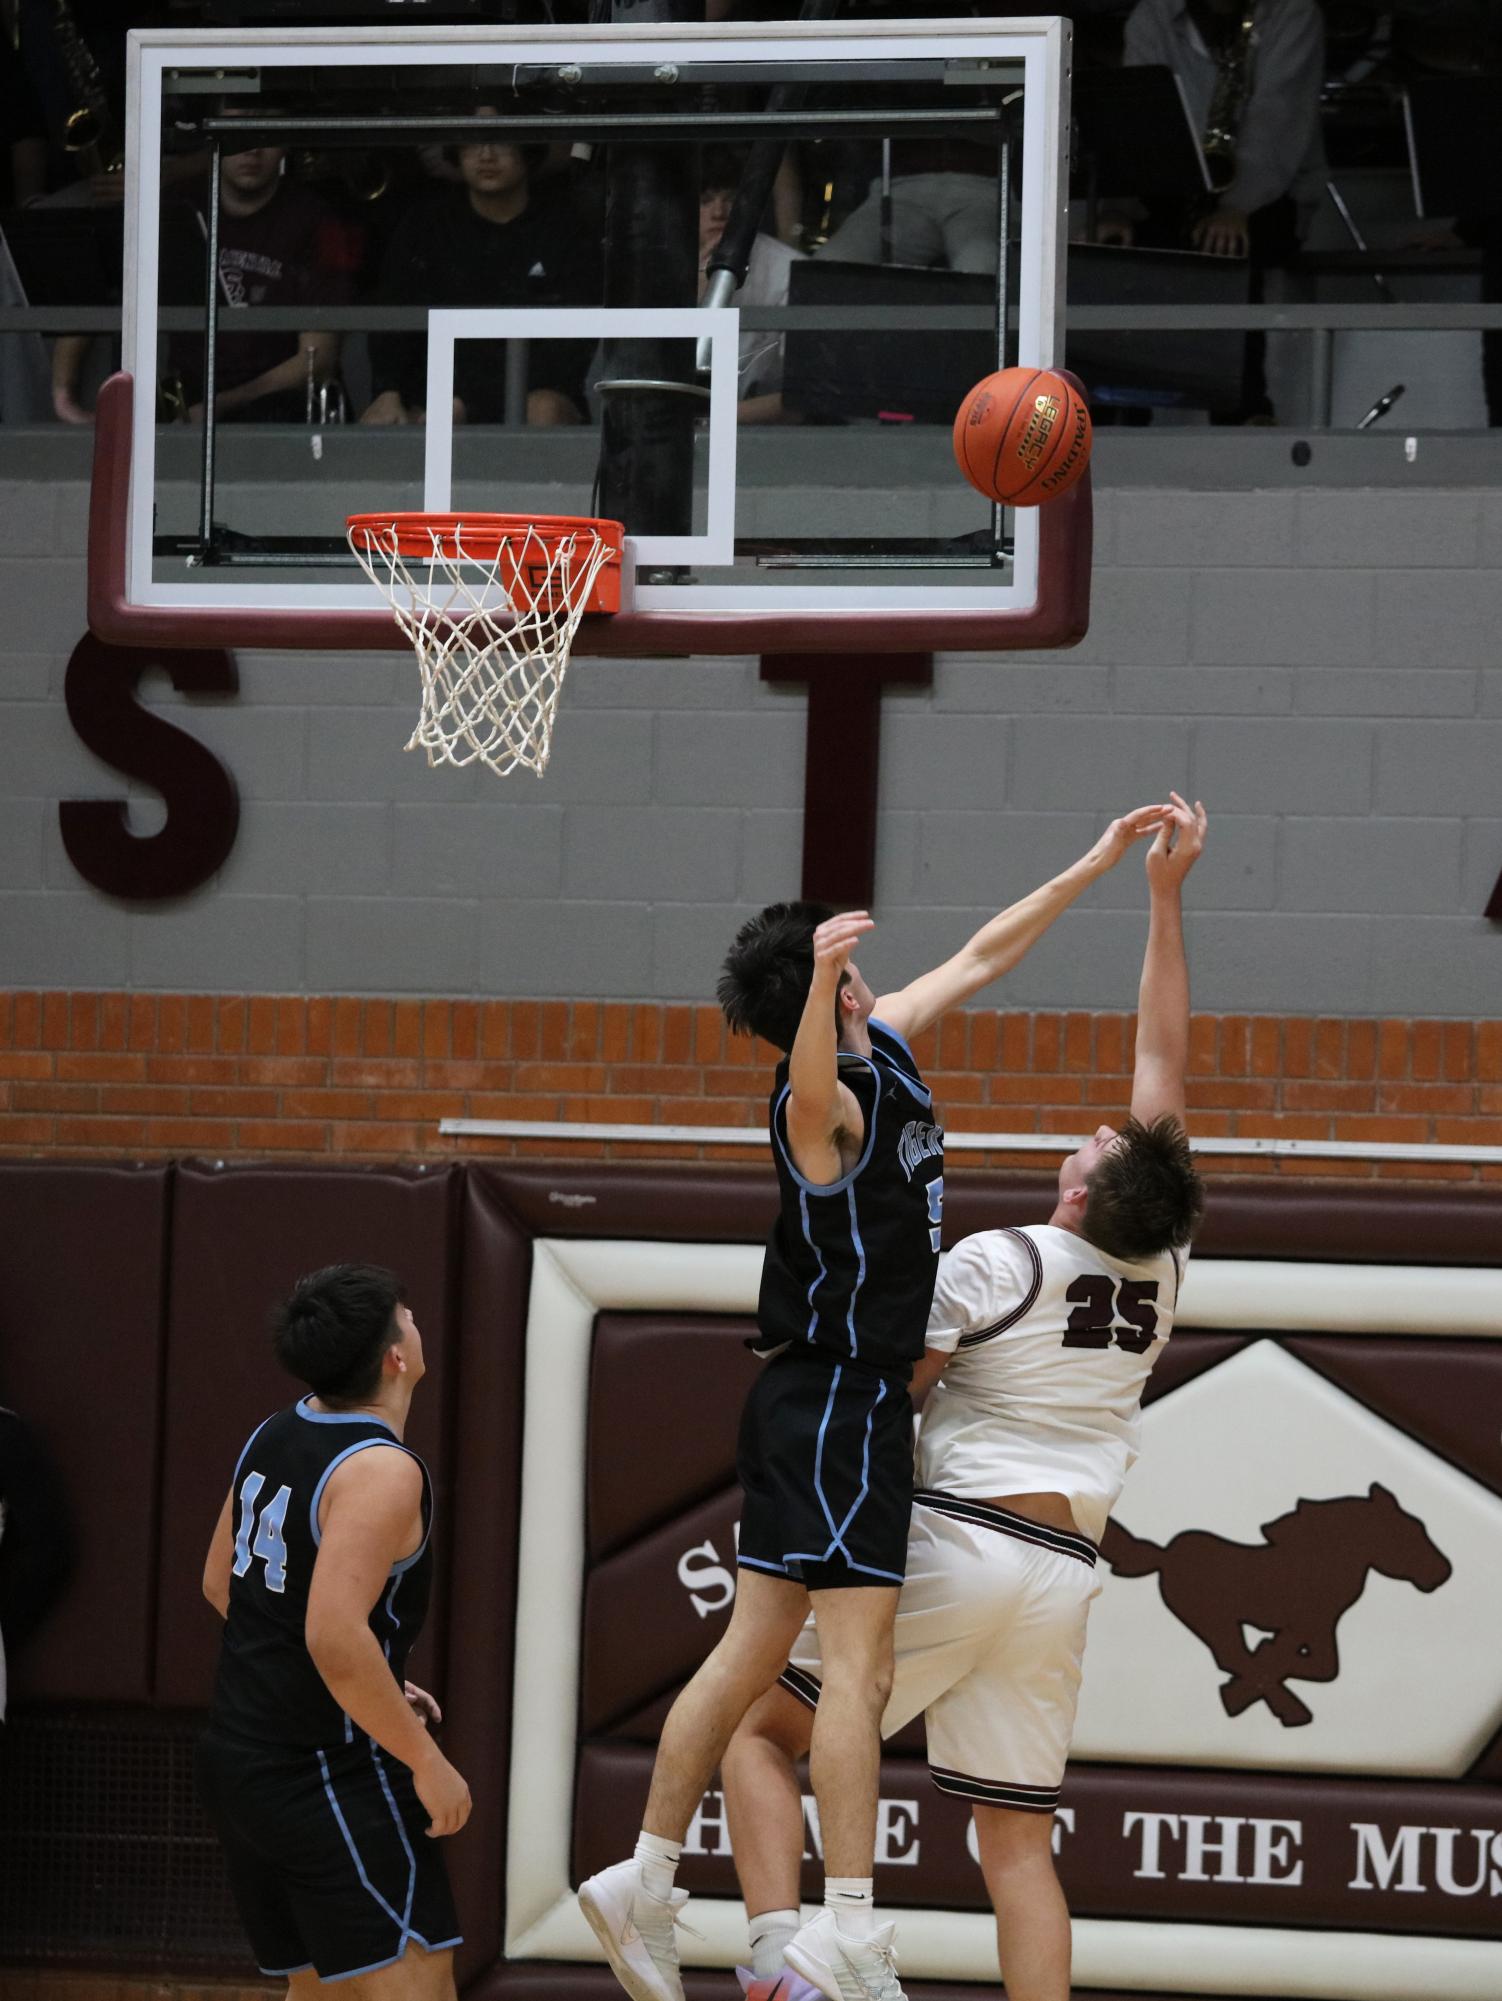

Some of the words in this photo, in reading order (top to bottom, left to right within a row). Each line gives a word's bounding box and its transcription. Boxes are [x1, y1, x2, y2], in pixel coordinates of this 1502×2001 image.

[1024, 395, 1061, 471] LEGACY
[1040, 402, 1088, 490] SPALDING
[1062, 1274, 1159, 1354] 25
[233, 1471, 292, 1593] 14
[1122, 1811, 1304, 1886] THE
